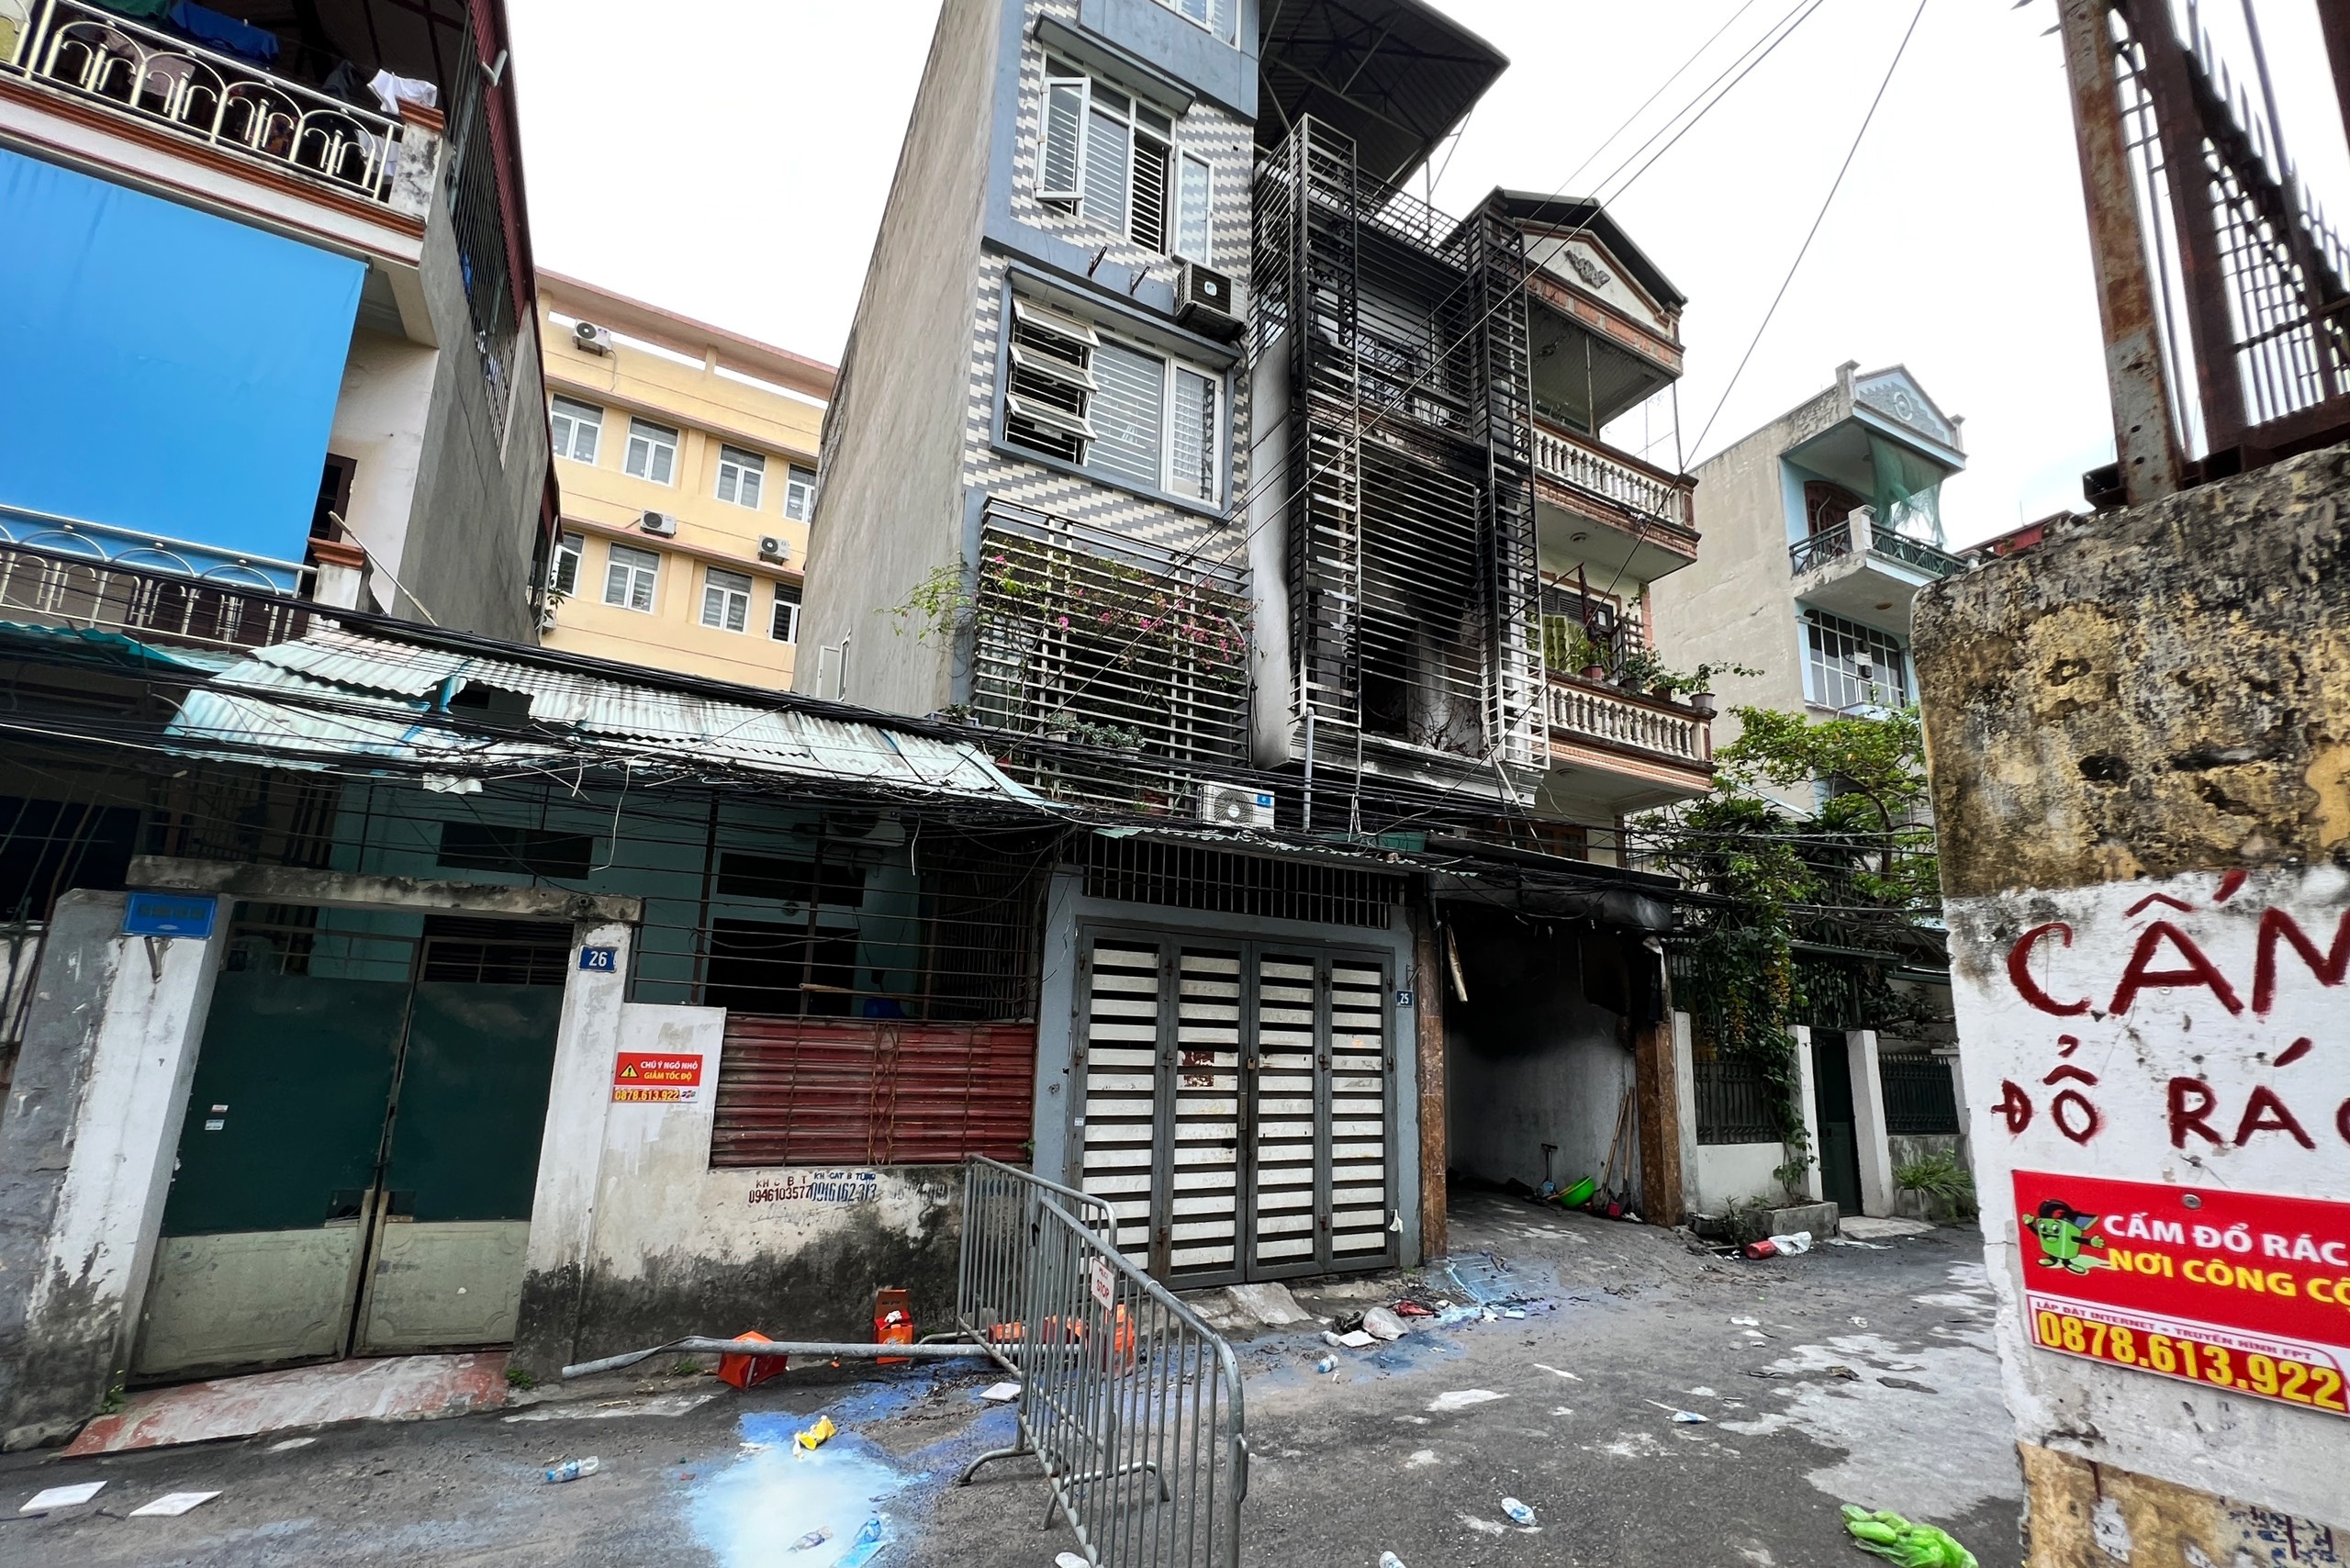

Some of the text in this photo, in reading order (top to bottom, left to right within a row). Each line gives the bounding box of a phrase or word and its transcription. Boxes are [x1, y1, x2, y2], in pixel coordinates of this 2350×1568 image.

[588, 950, 609, 967] 26
[1400, 993, 1409, 1004] 25
[680, 1071, 692, 1082] ĐỘ
[1991, 1034, 2106, 1146] ĐỔ
[614, 1089, 679, 1101] 0878.613.922
[2103, 1212, 2349, 1267] CẤM ĐỔ RÁC
[1097, 1279, 1110, 1299] STOP
[2108, 1248, 2175, 1278] NƠI
[2181, 1258, 2297, 1297] CÔNG
[2090, 1312, 2156, 1331] INTERNET
[2282, 1349, 2311, 1361] FPT
[2038, 1311, 2345, 1411] 0878.613.922
